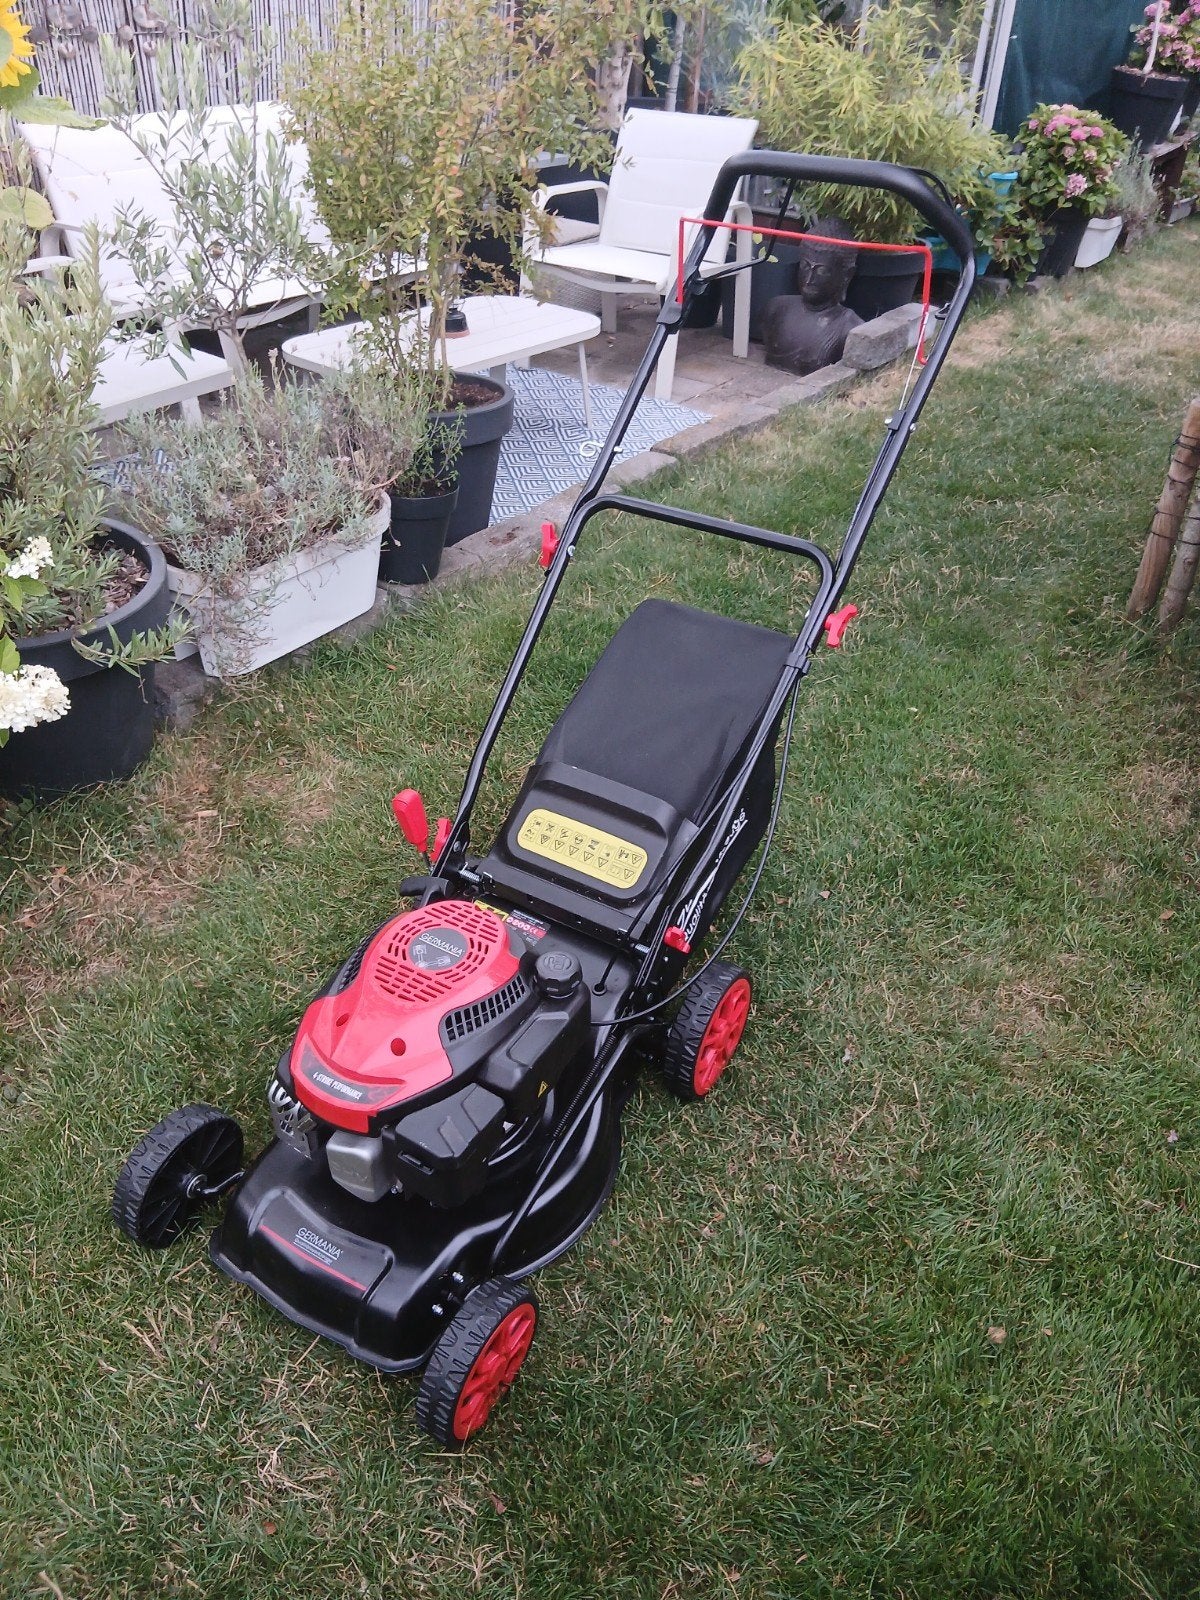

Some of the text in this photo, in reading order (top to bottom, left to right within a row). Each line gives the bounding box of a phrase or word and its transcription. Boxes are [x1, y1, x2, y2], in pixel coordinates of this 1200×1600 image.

[420, 932, 463, 956] GERMANIA
[331, 1080, 364, 1100] PERFORMANCE
[297, 1227, 341, 1258] GERMANIA
